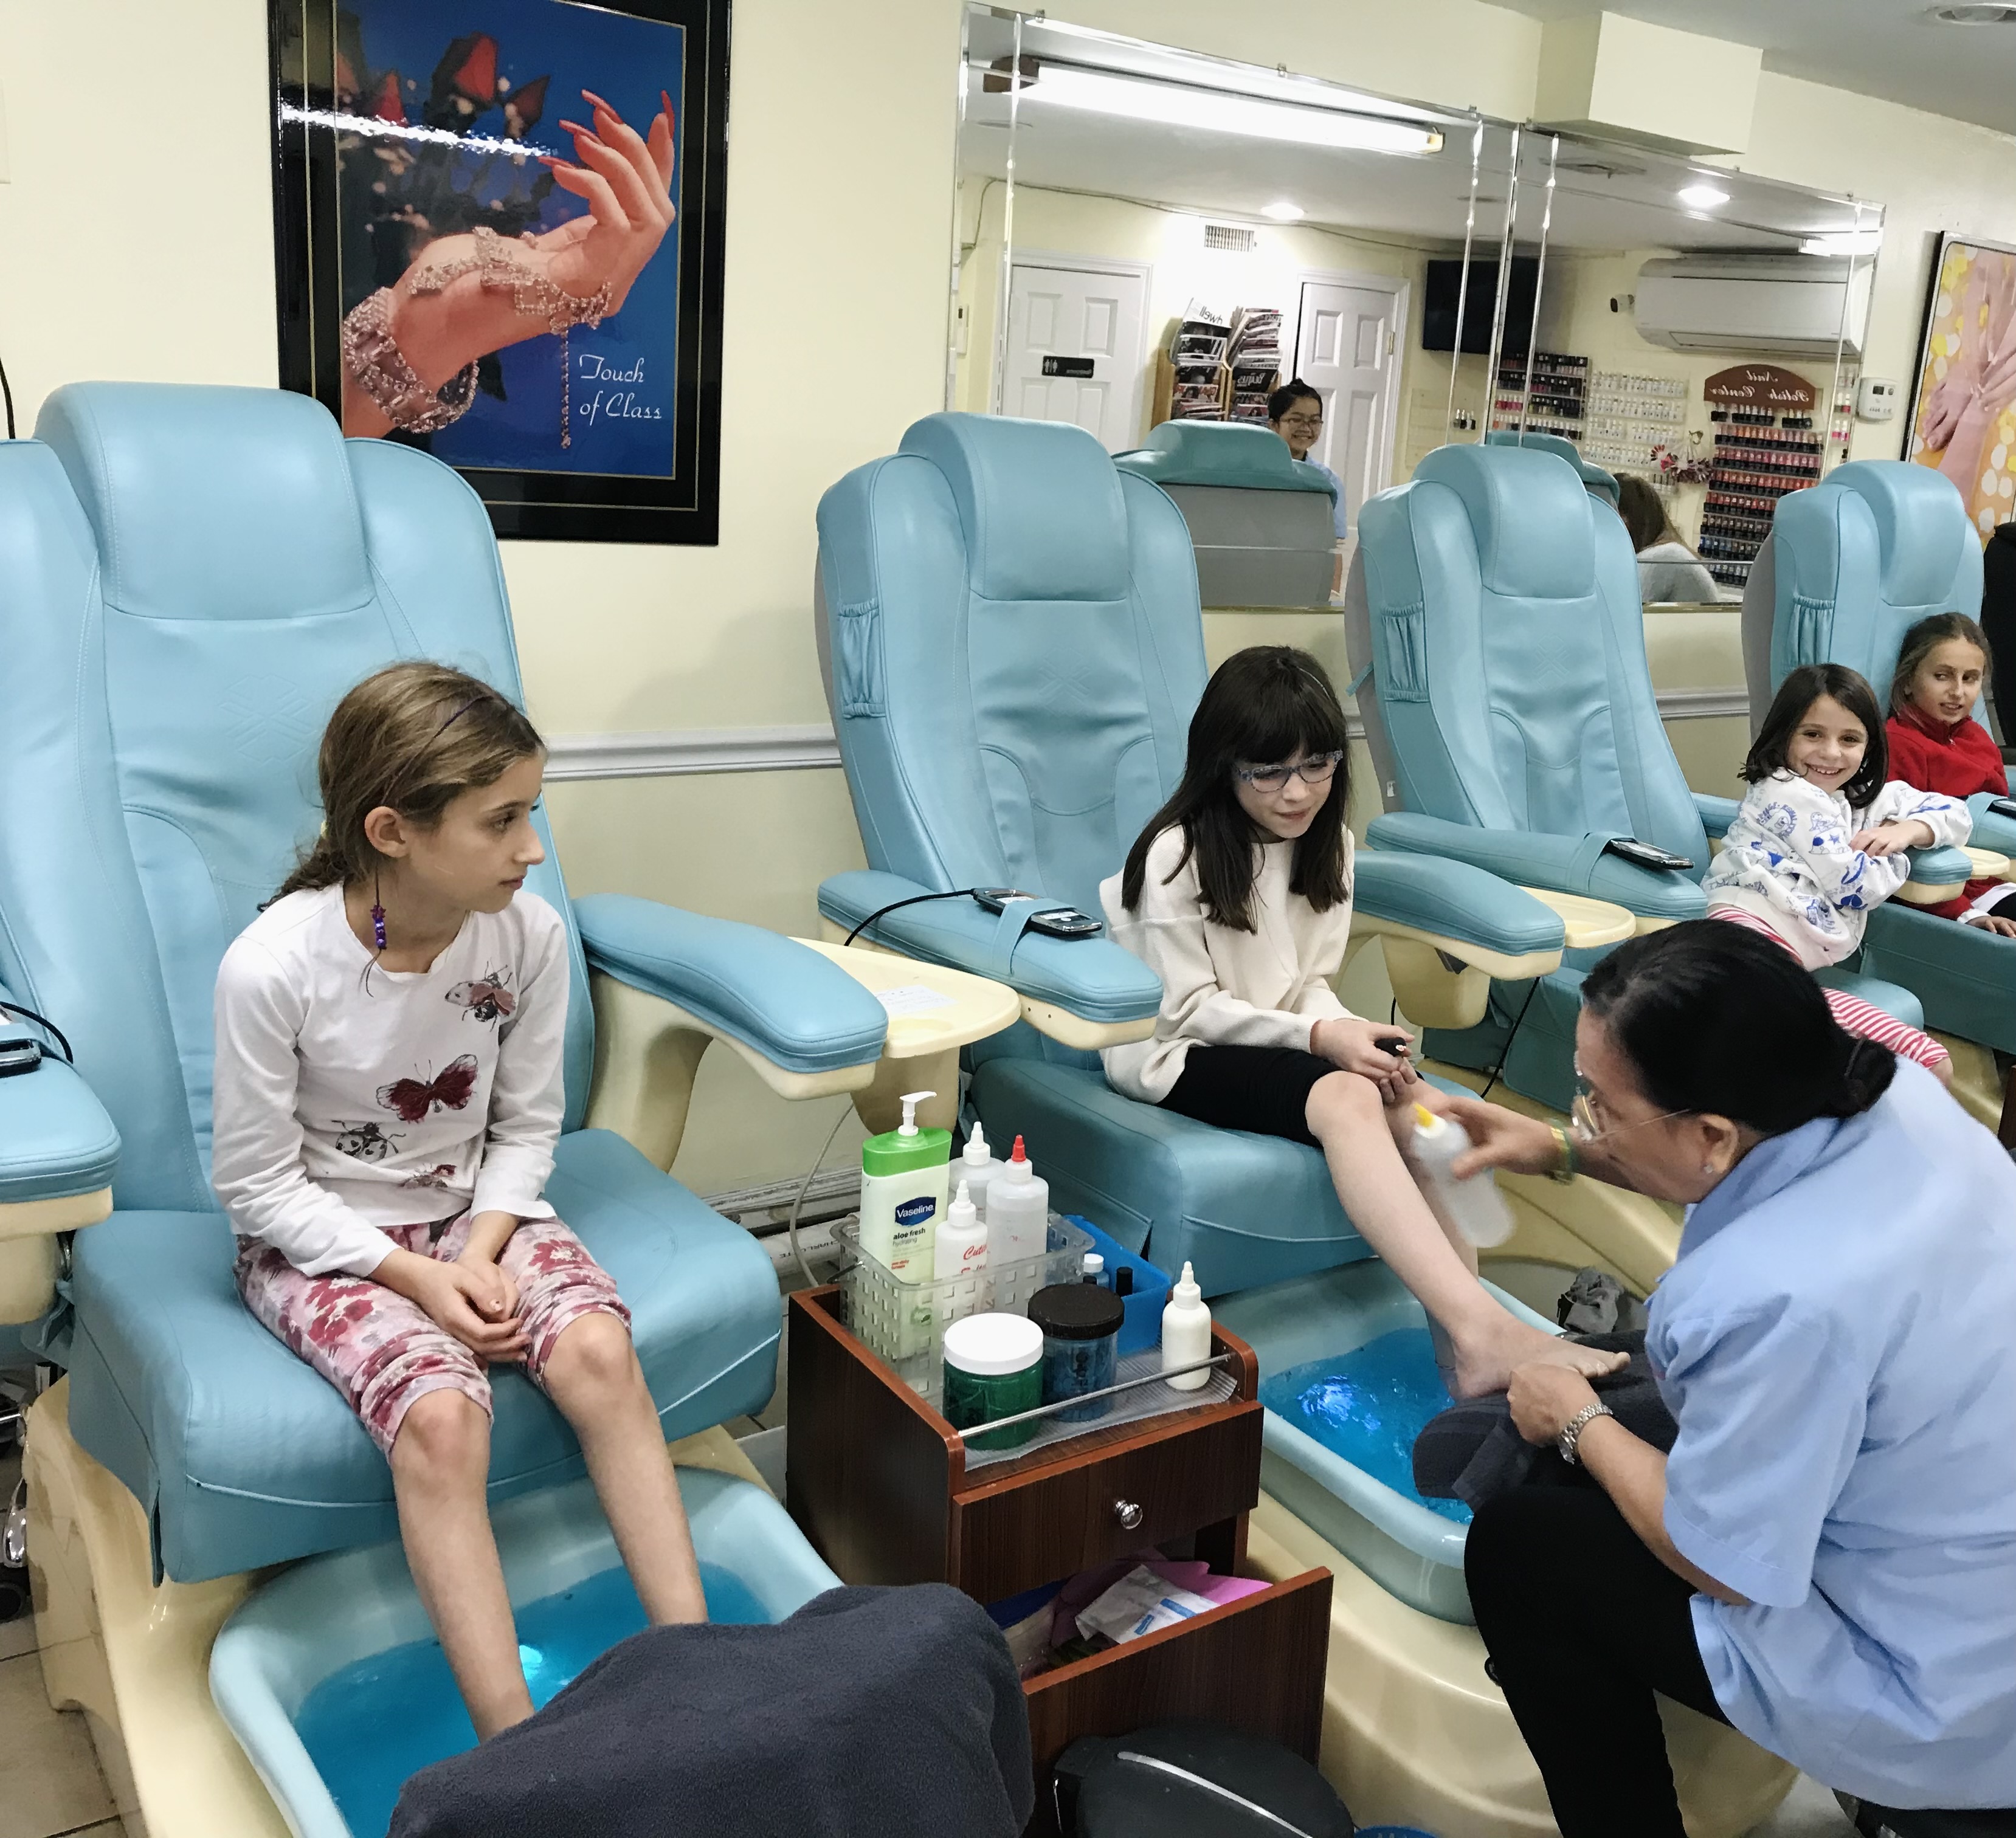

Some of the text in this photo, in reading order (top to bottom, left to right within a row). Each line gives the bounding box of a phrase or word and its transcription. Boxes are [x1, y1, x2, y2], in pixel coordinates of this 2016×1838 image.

[579, 354, 644, 383] Touch
[579, 390, 662, 426] of Class
[897, 1204, 934, 1218] Vaseline
[910, 1227, 926, 1237] fresh
